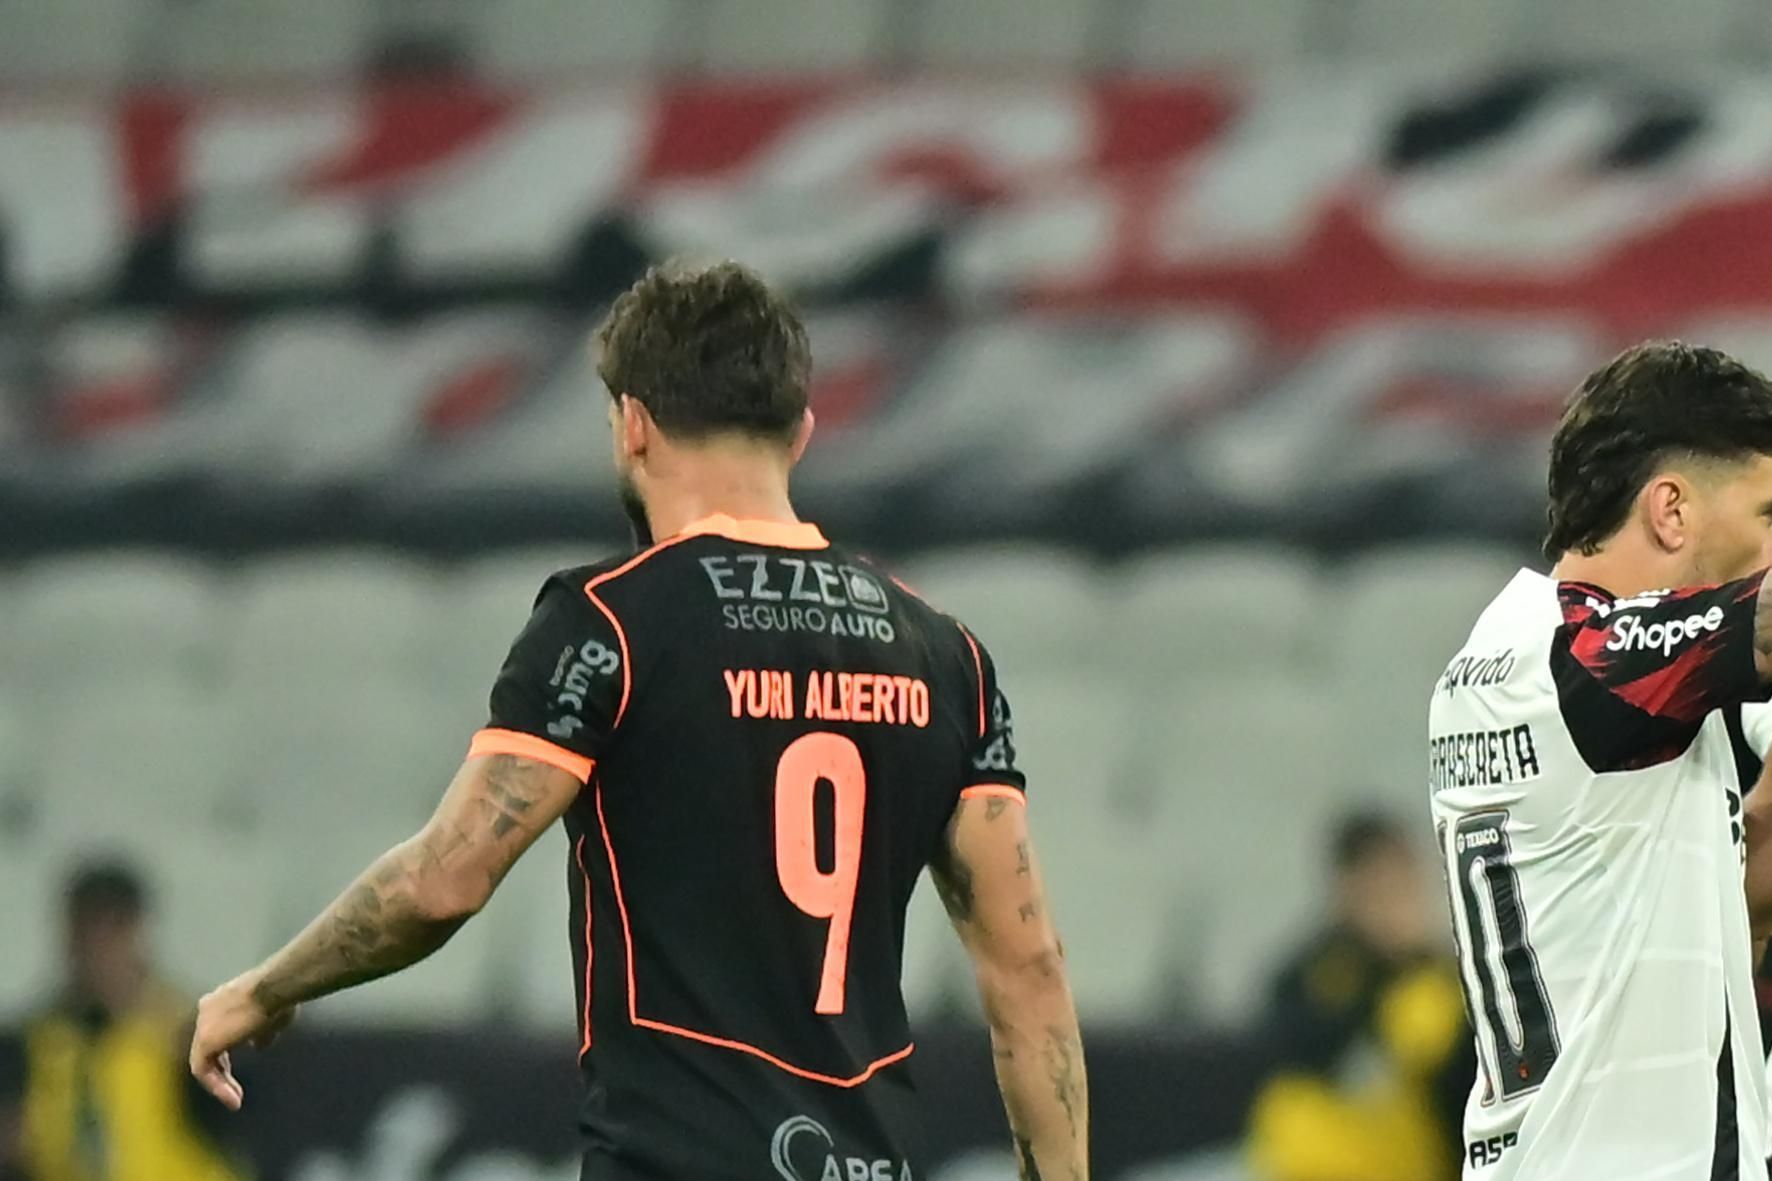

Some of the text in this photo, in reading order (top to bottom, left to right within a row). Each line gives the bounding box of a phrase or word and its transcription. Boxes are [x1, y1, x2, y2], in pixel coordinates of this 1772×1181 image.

[1606, 606, 1724, 657] Shopee
[723, 668, 930, 728] YURI ALBERTO
[774, 731, 867, 1014] 9
